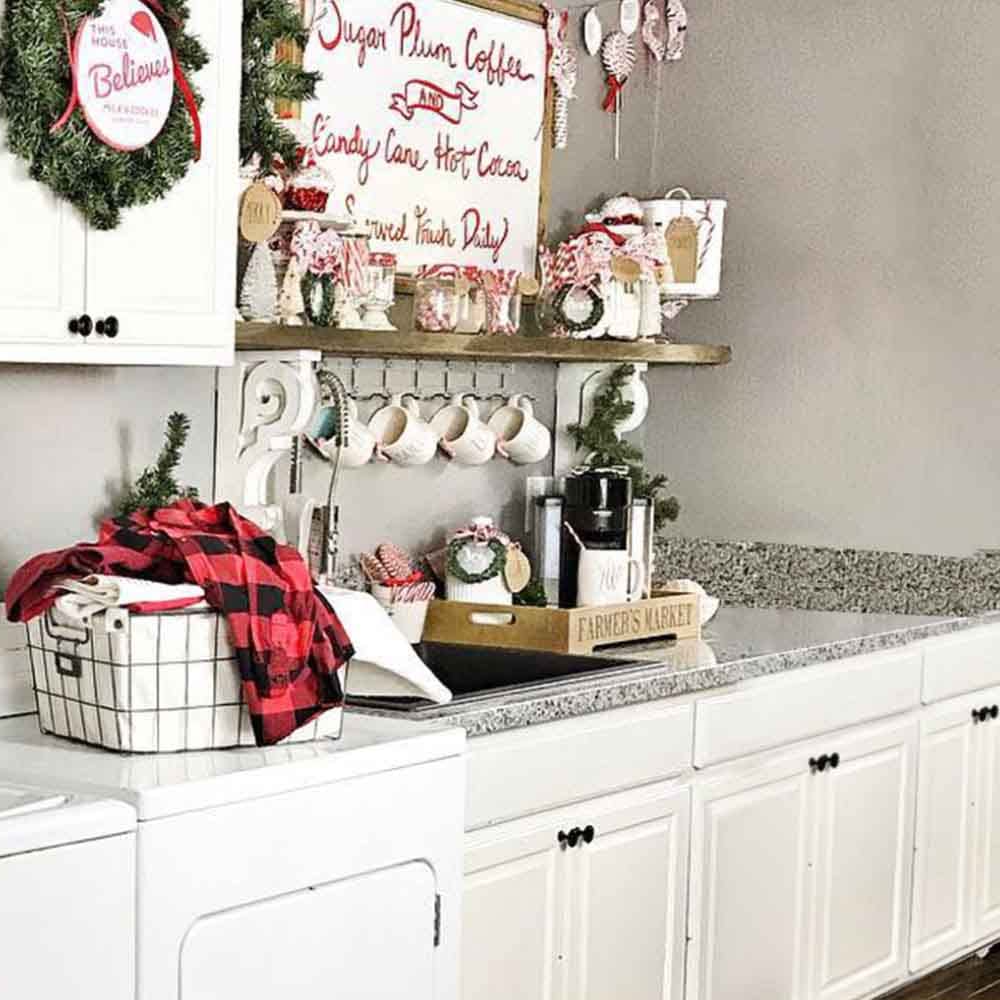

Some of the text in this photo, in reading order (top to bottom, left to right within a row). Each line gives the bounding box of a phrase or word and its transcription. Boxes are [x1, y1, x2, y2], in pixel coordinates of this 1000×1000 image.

[91, 24, 116, 36] THIS
[91, 36, 129, 50] HOUSE
[318, 0, 535, 86] Sugar Plum Coffee
[88, 52, 170, 99] Believes
[418, 88, 444, 112] AND
[312, 113, 528, 186] Candy Cane Hot Cocoa
[345, 193, 408, 242] Srved
[461, 207, 509, 263] Daily
[578, 603, 692, 642] FARMER'S MARKET
